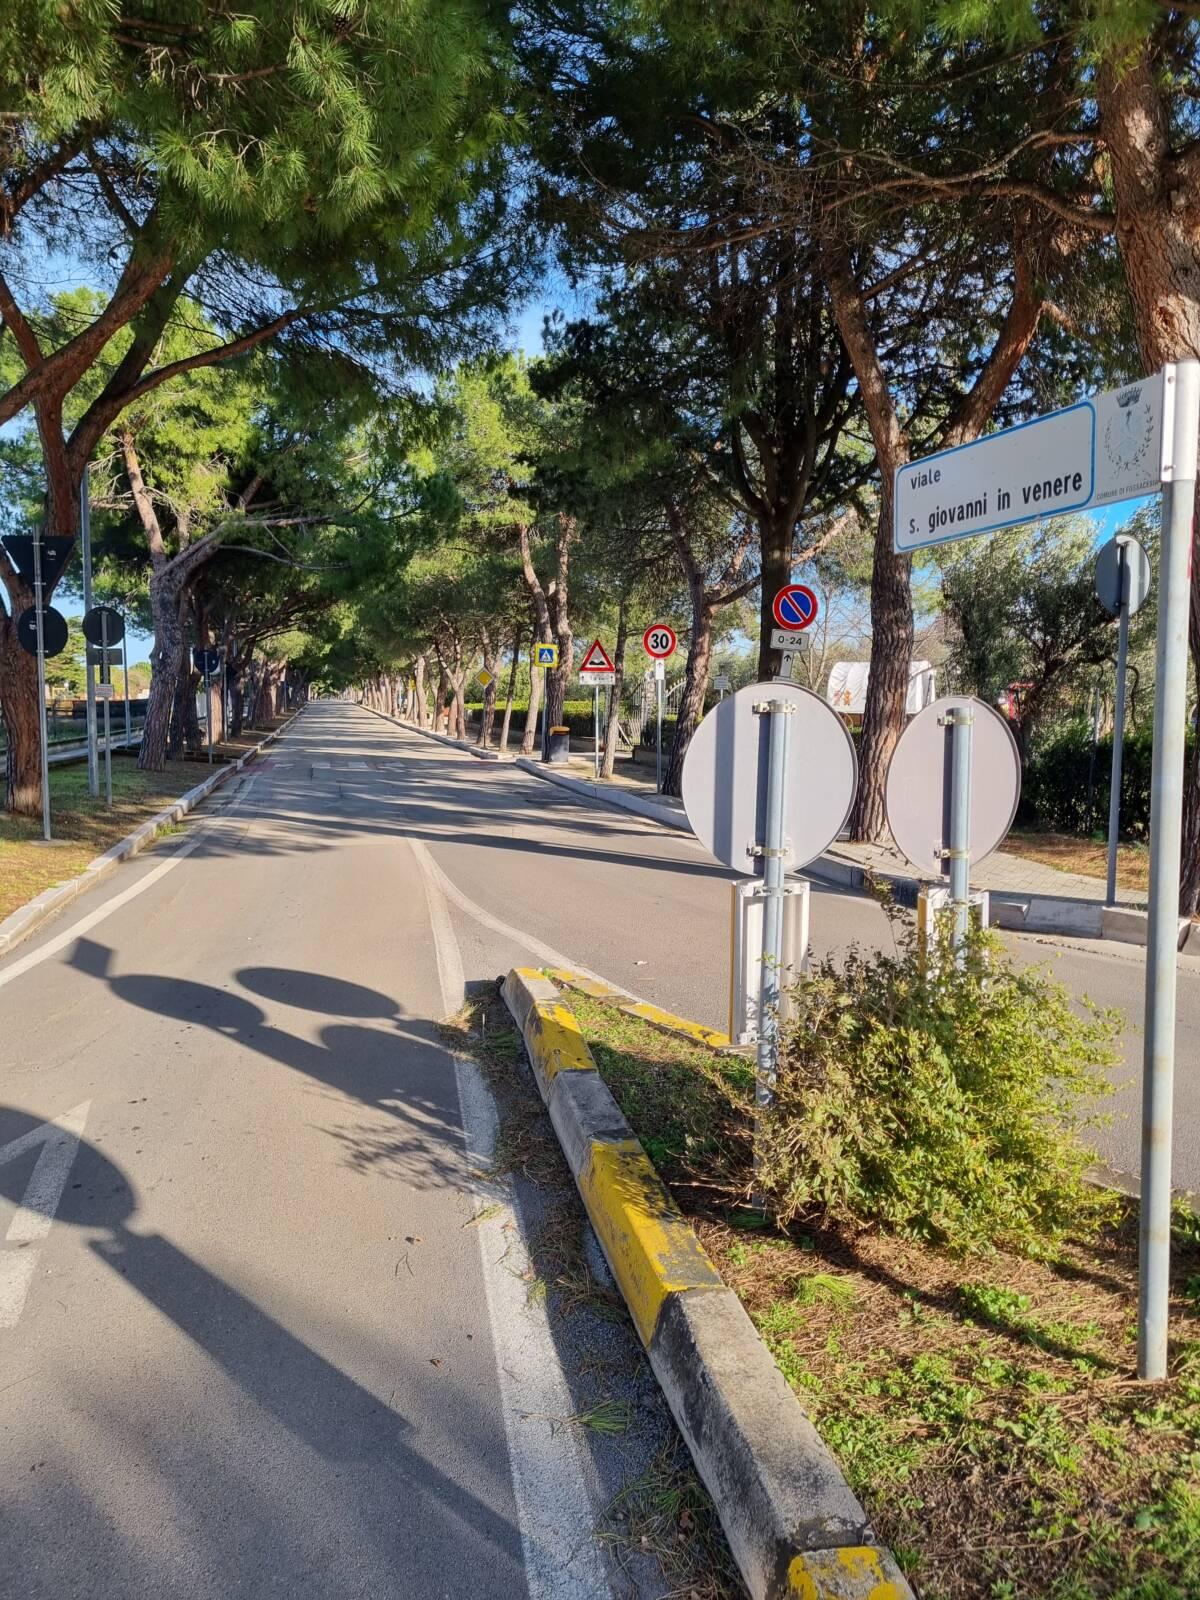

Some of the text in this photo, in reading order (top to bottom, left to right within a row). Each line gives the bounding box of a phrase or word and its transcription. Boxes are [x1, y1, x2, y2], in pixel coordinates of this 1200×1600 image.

[910, 468, 941, 490] viale
[909, 472, 1082, 534] s. giovanni in venere
[651, 633, 669, 649] 30
